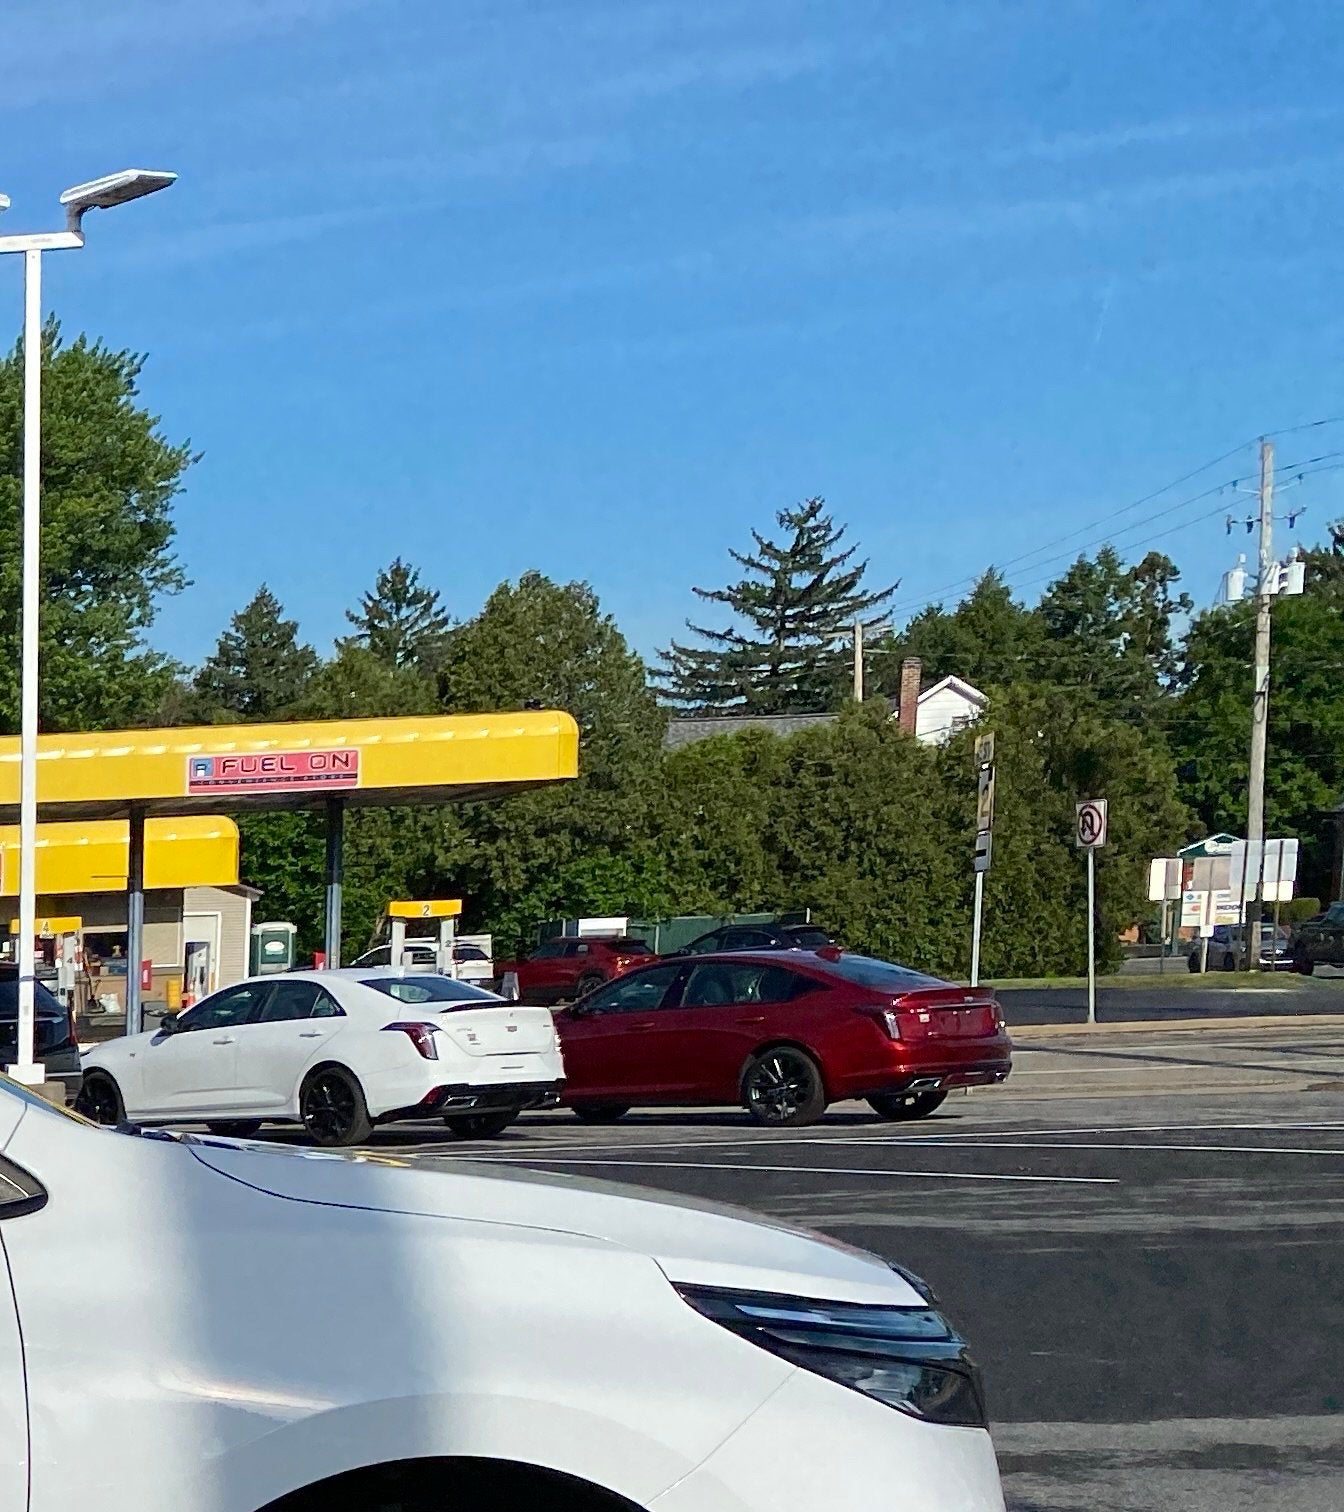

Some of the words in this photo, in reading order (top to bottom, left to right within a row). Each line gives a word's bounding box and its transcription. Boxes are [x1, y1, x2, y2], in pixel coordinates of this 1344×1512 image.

[222, 757, 295, 773] FUEL
[310, 752, 349, 769] ON
[423, 905, 430, 916] 2
[42, 921, 50, 932] 4
